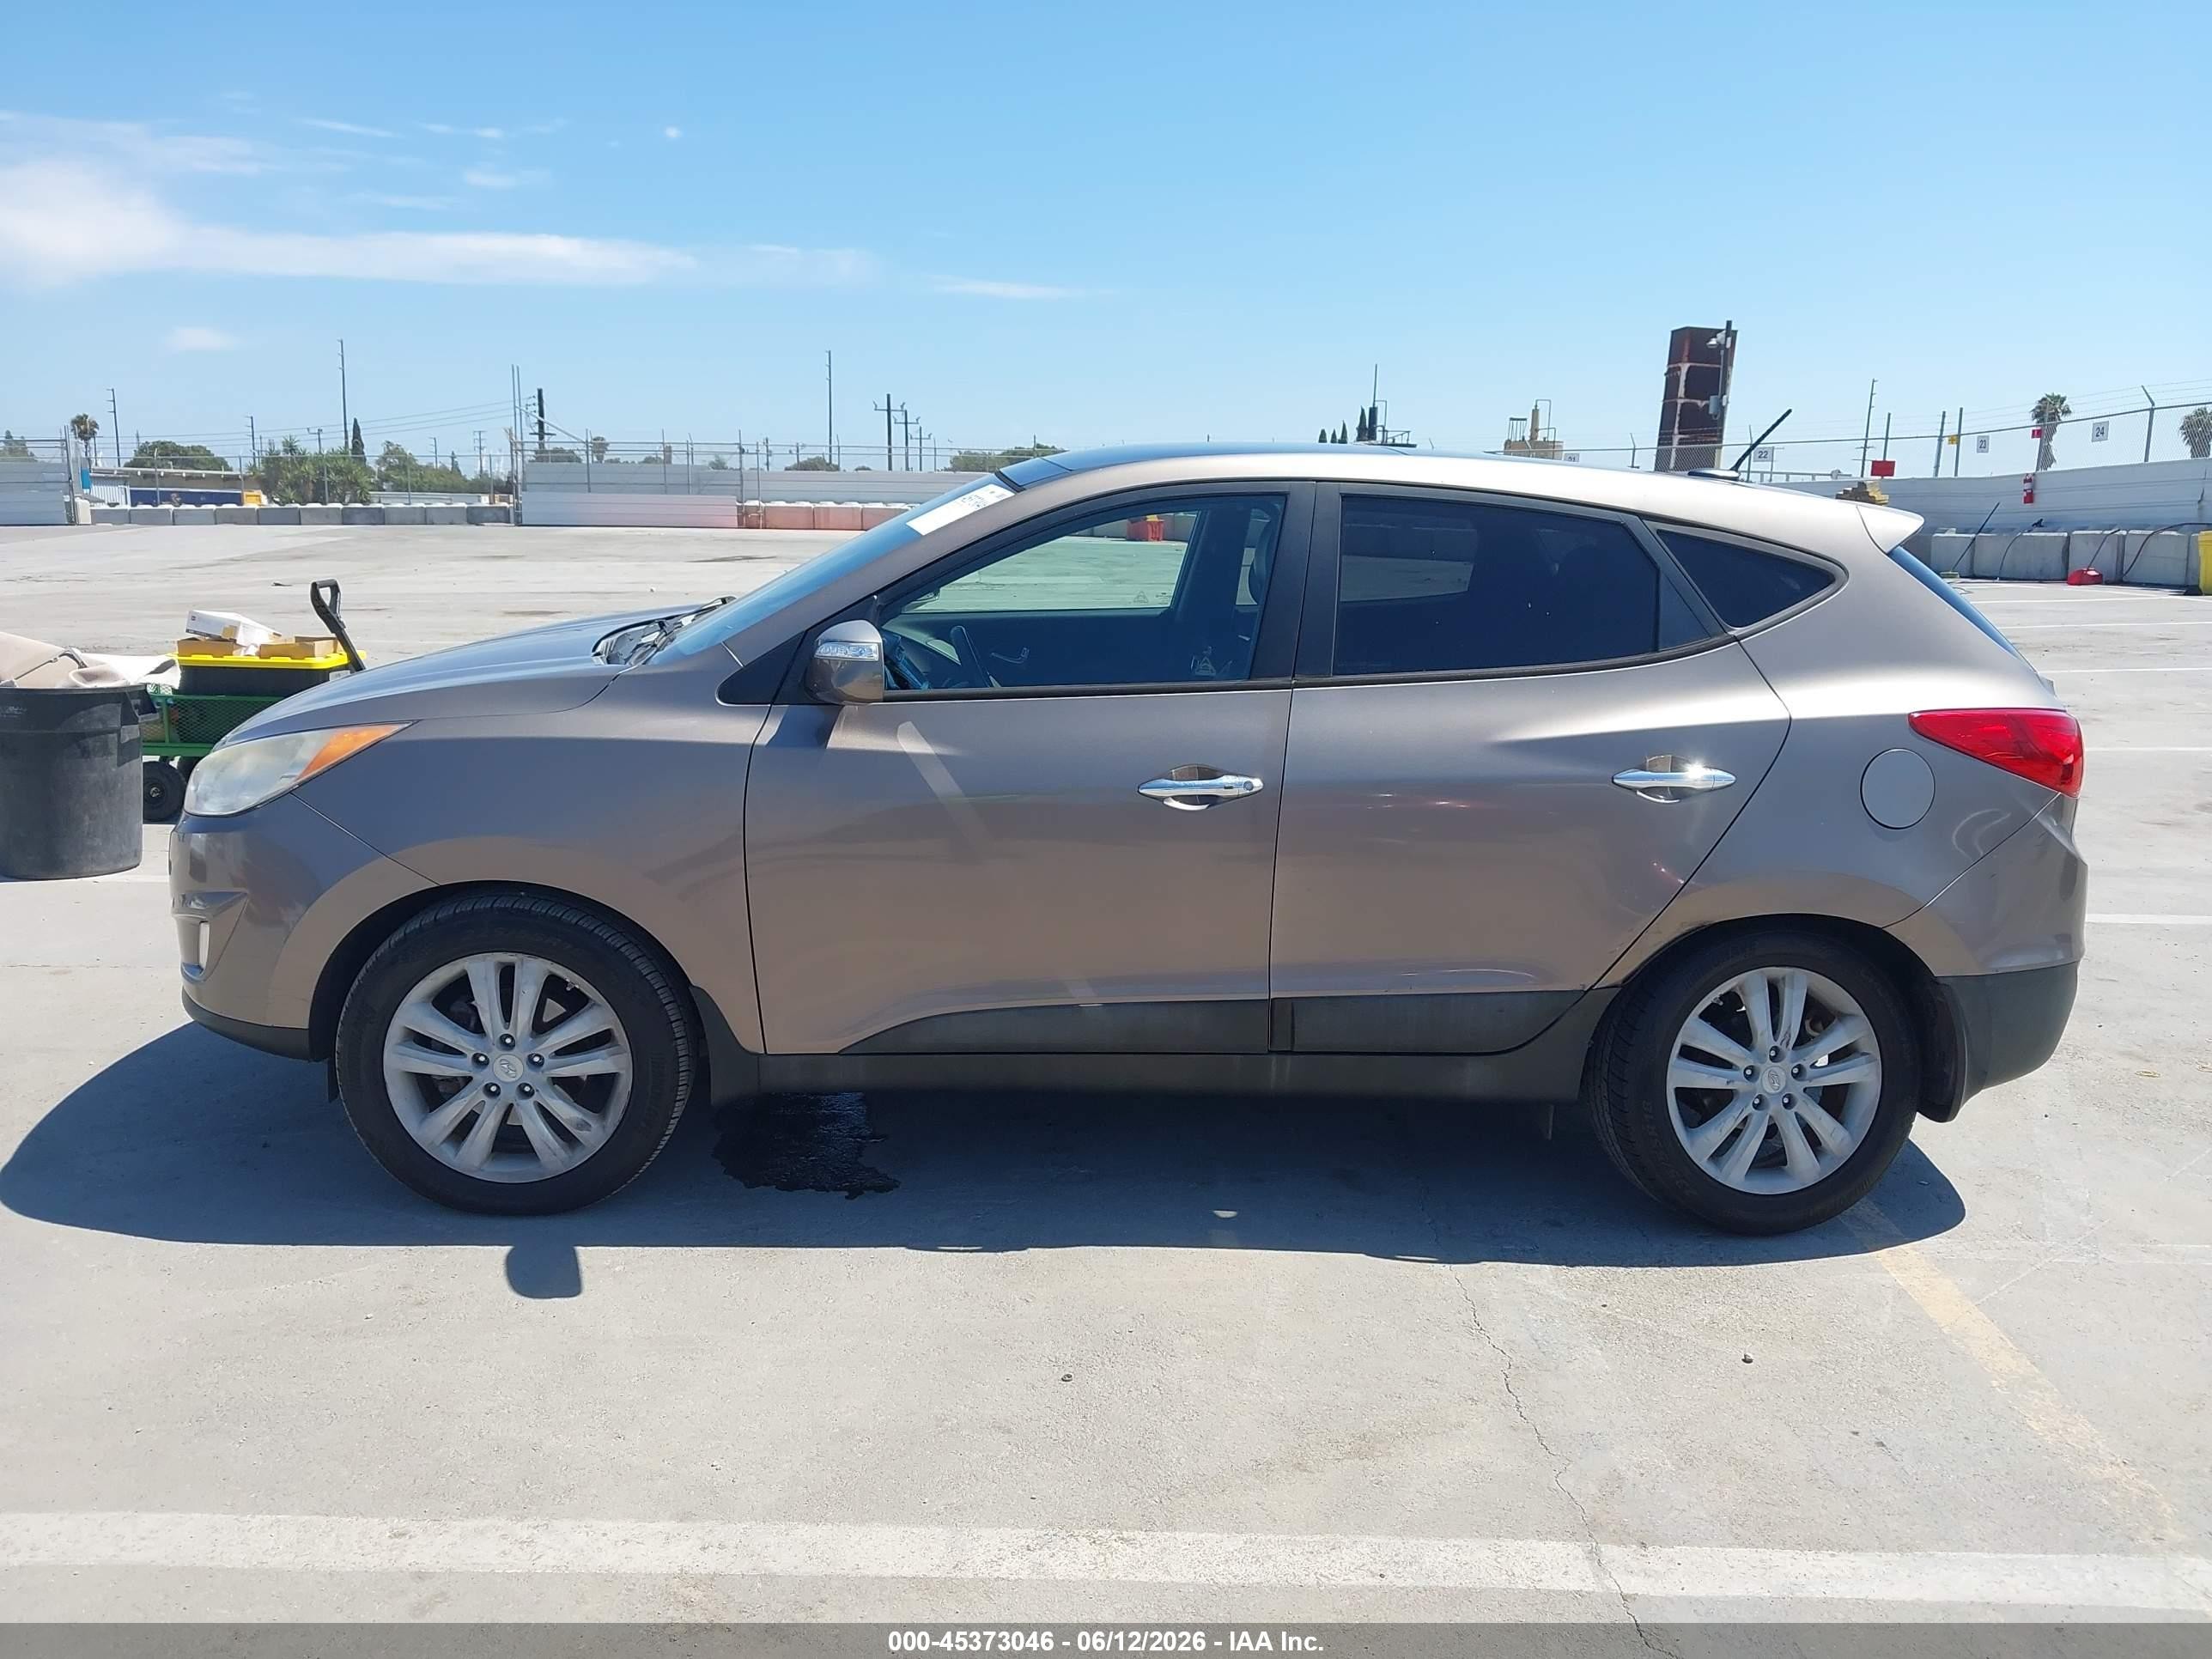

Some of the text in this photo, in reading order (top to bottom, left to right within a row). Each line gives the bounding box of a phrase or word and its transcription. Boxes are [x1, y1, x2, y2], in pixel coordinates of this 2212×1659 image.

[2095, 426, 2105, 437] 24
[1978, 439, 1987, 449] 23
[1758, 450, 1769, 459] 22
